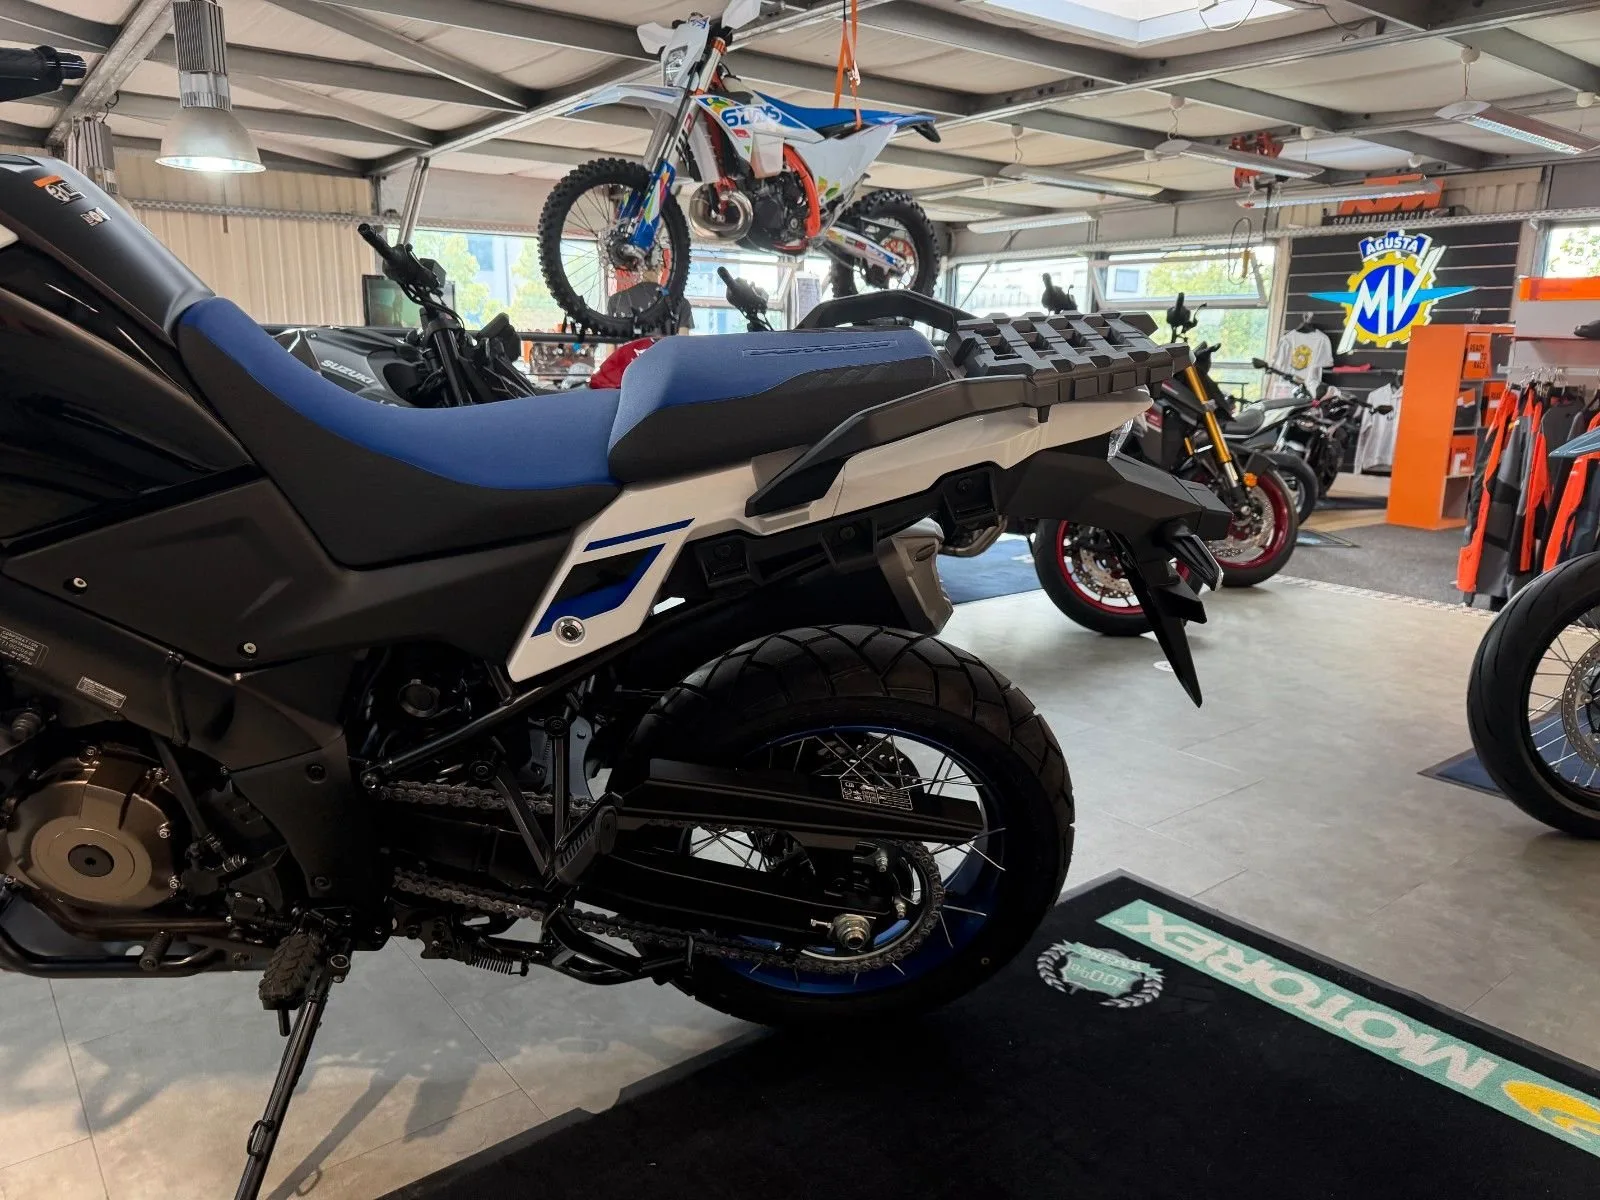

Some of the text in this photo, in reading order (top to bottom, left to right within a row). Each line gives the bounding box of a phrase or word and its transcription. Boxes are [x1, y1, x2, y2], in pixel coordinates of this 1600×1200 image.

[1333, 210, 1435, 225] SPORTMOTORCYCLES
[1366, 236, 1418, 256] AGUSTA
[1336, 245, 1447, 355] MV
[321, 359, 375, 384] SUZUKI
[1121, 909, 1499, 1090] MOTOREX
